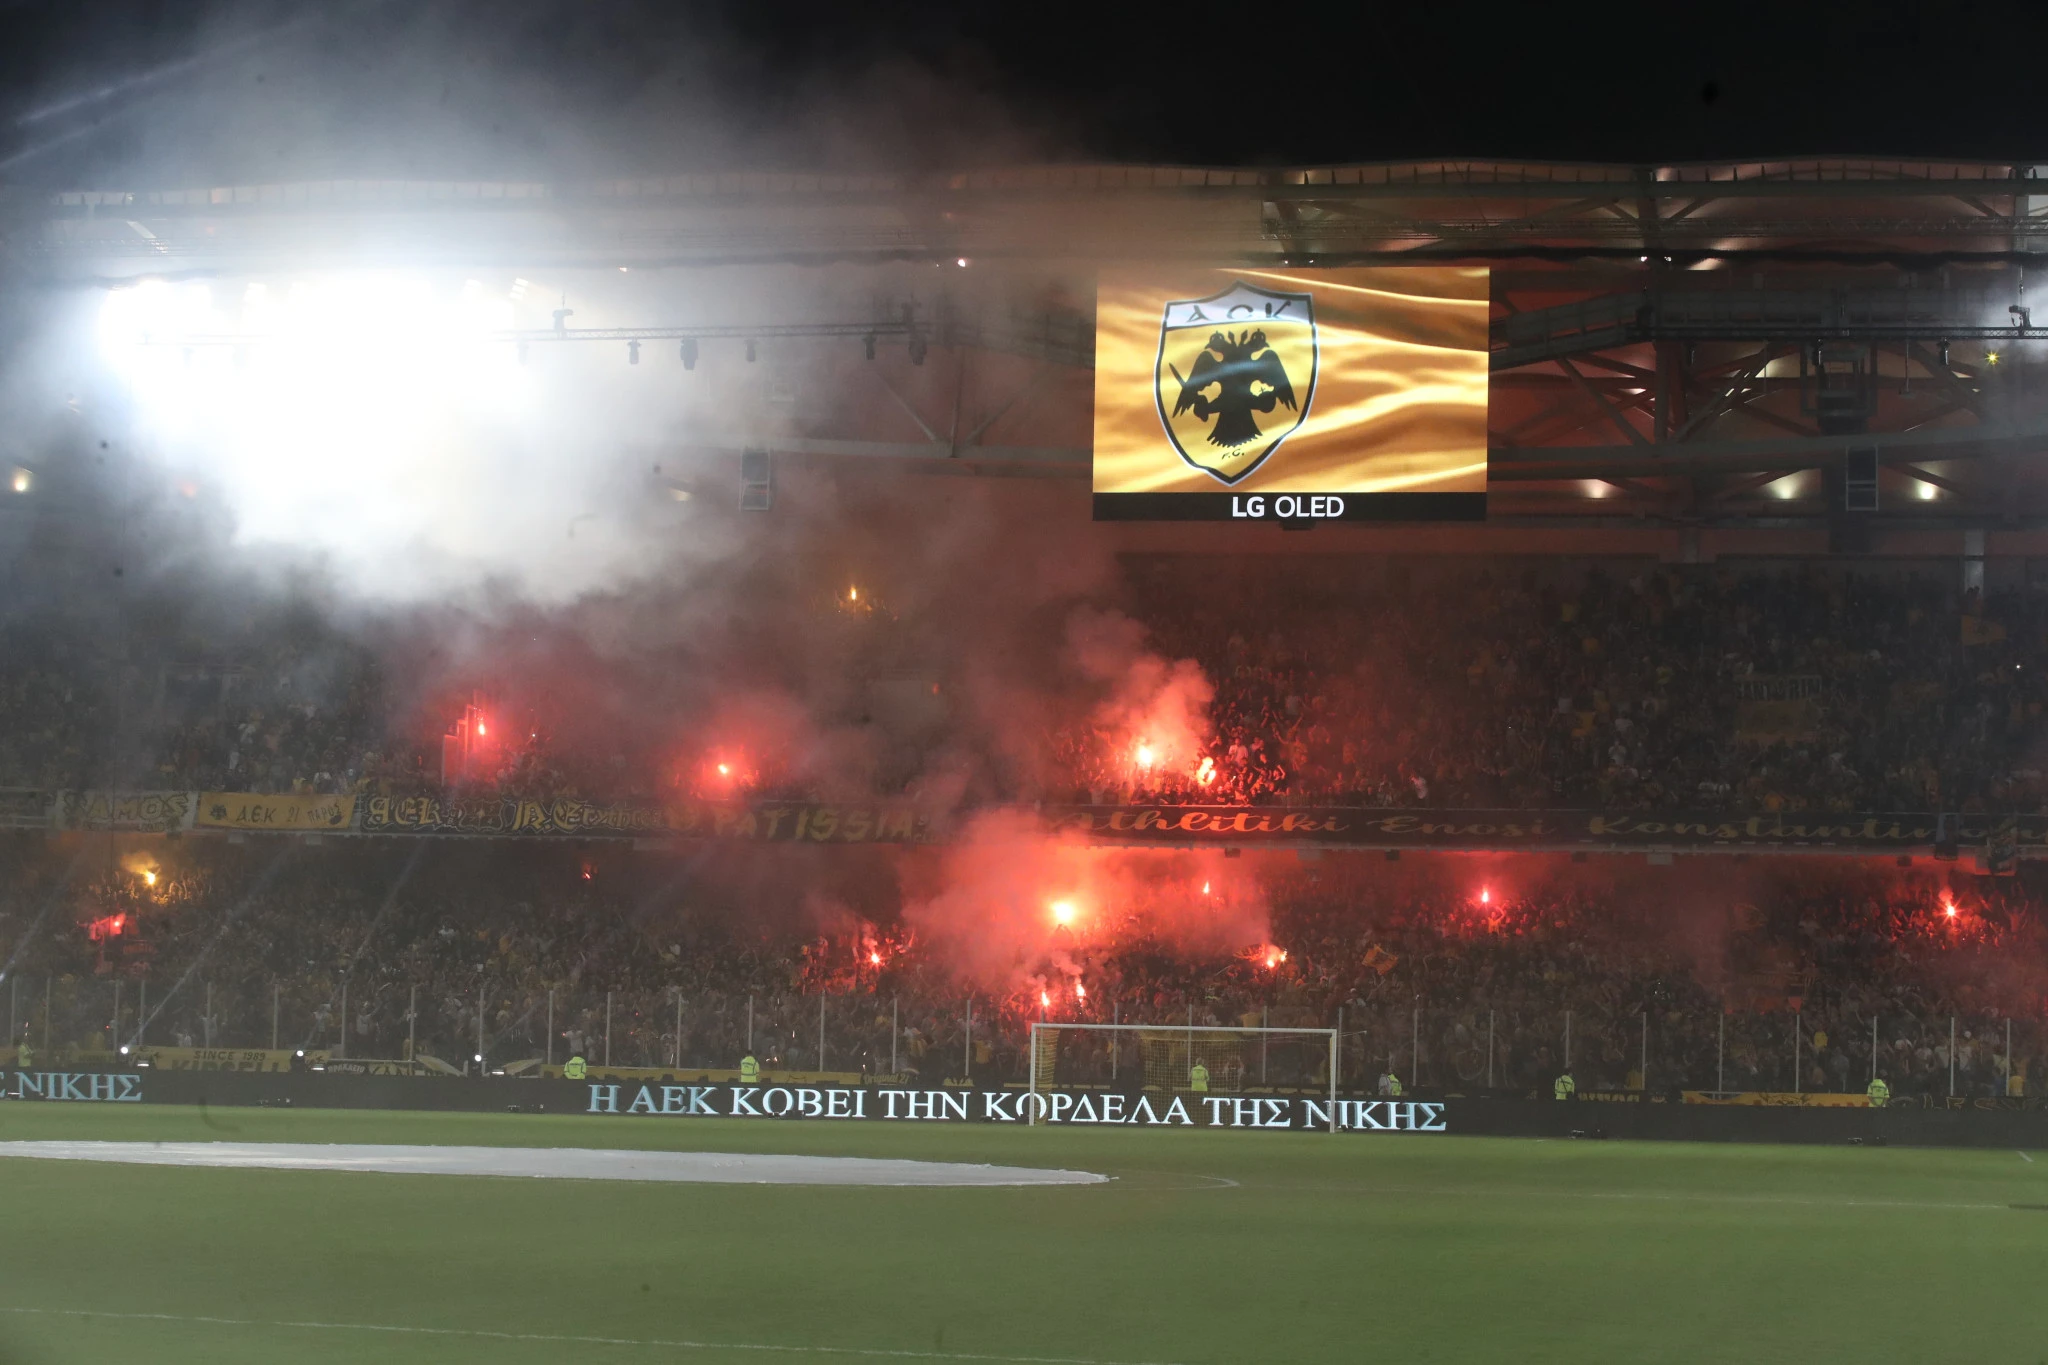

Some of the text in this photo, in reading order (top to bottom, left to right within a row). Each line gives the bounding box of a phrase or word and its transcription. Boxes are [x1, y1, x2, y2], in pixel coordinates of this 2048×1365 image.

[1232, 496, 1345, 518] LG OLED
[1366, 815, 1557, 837] Enosi
[194, 1050, 235, 1061] SINCE
